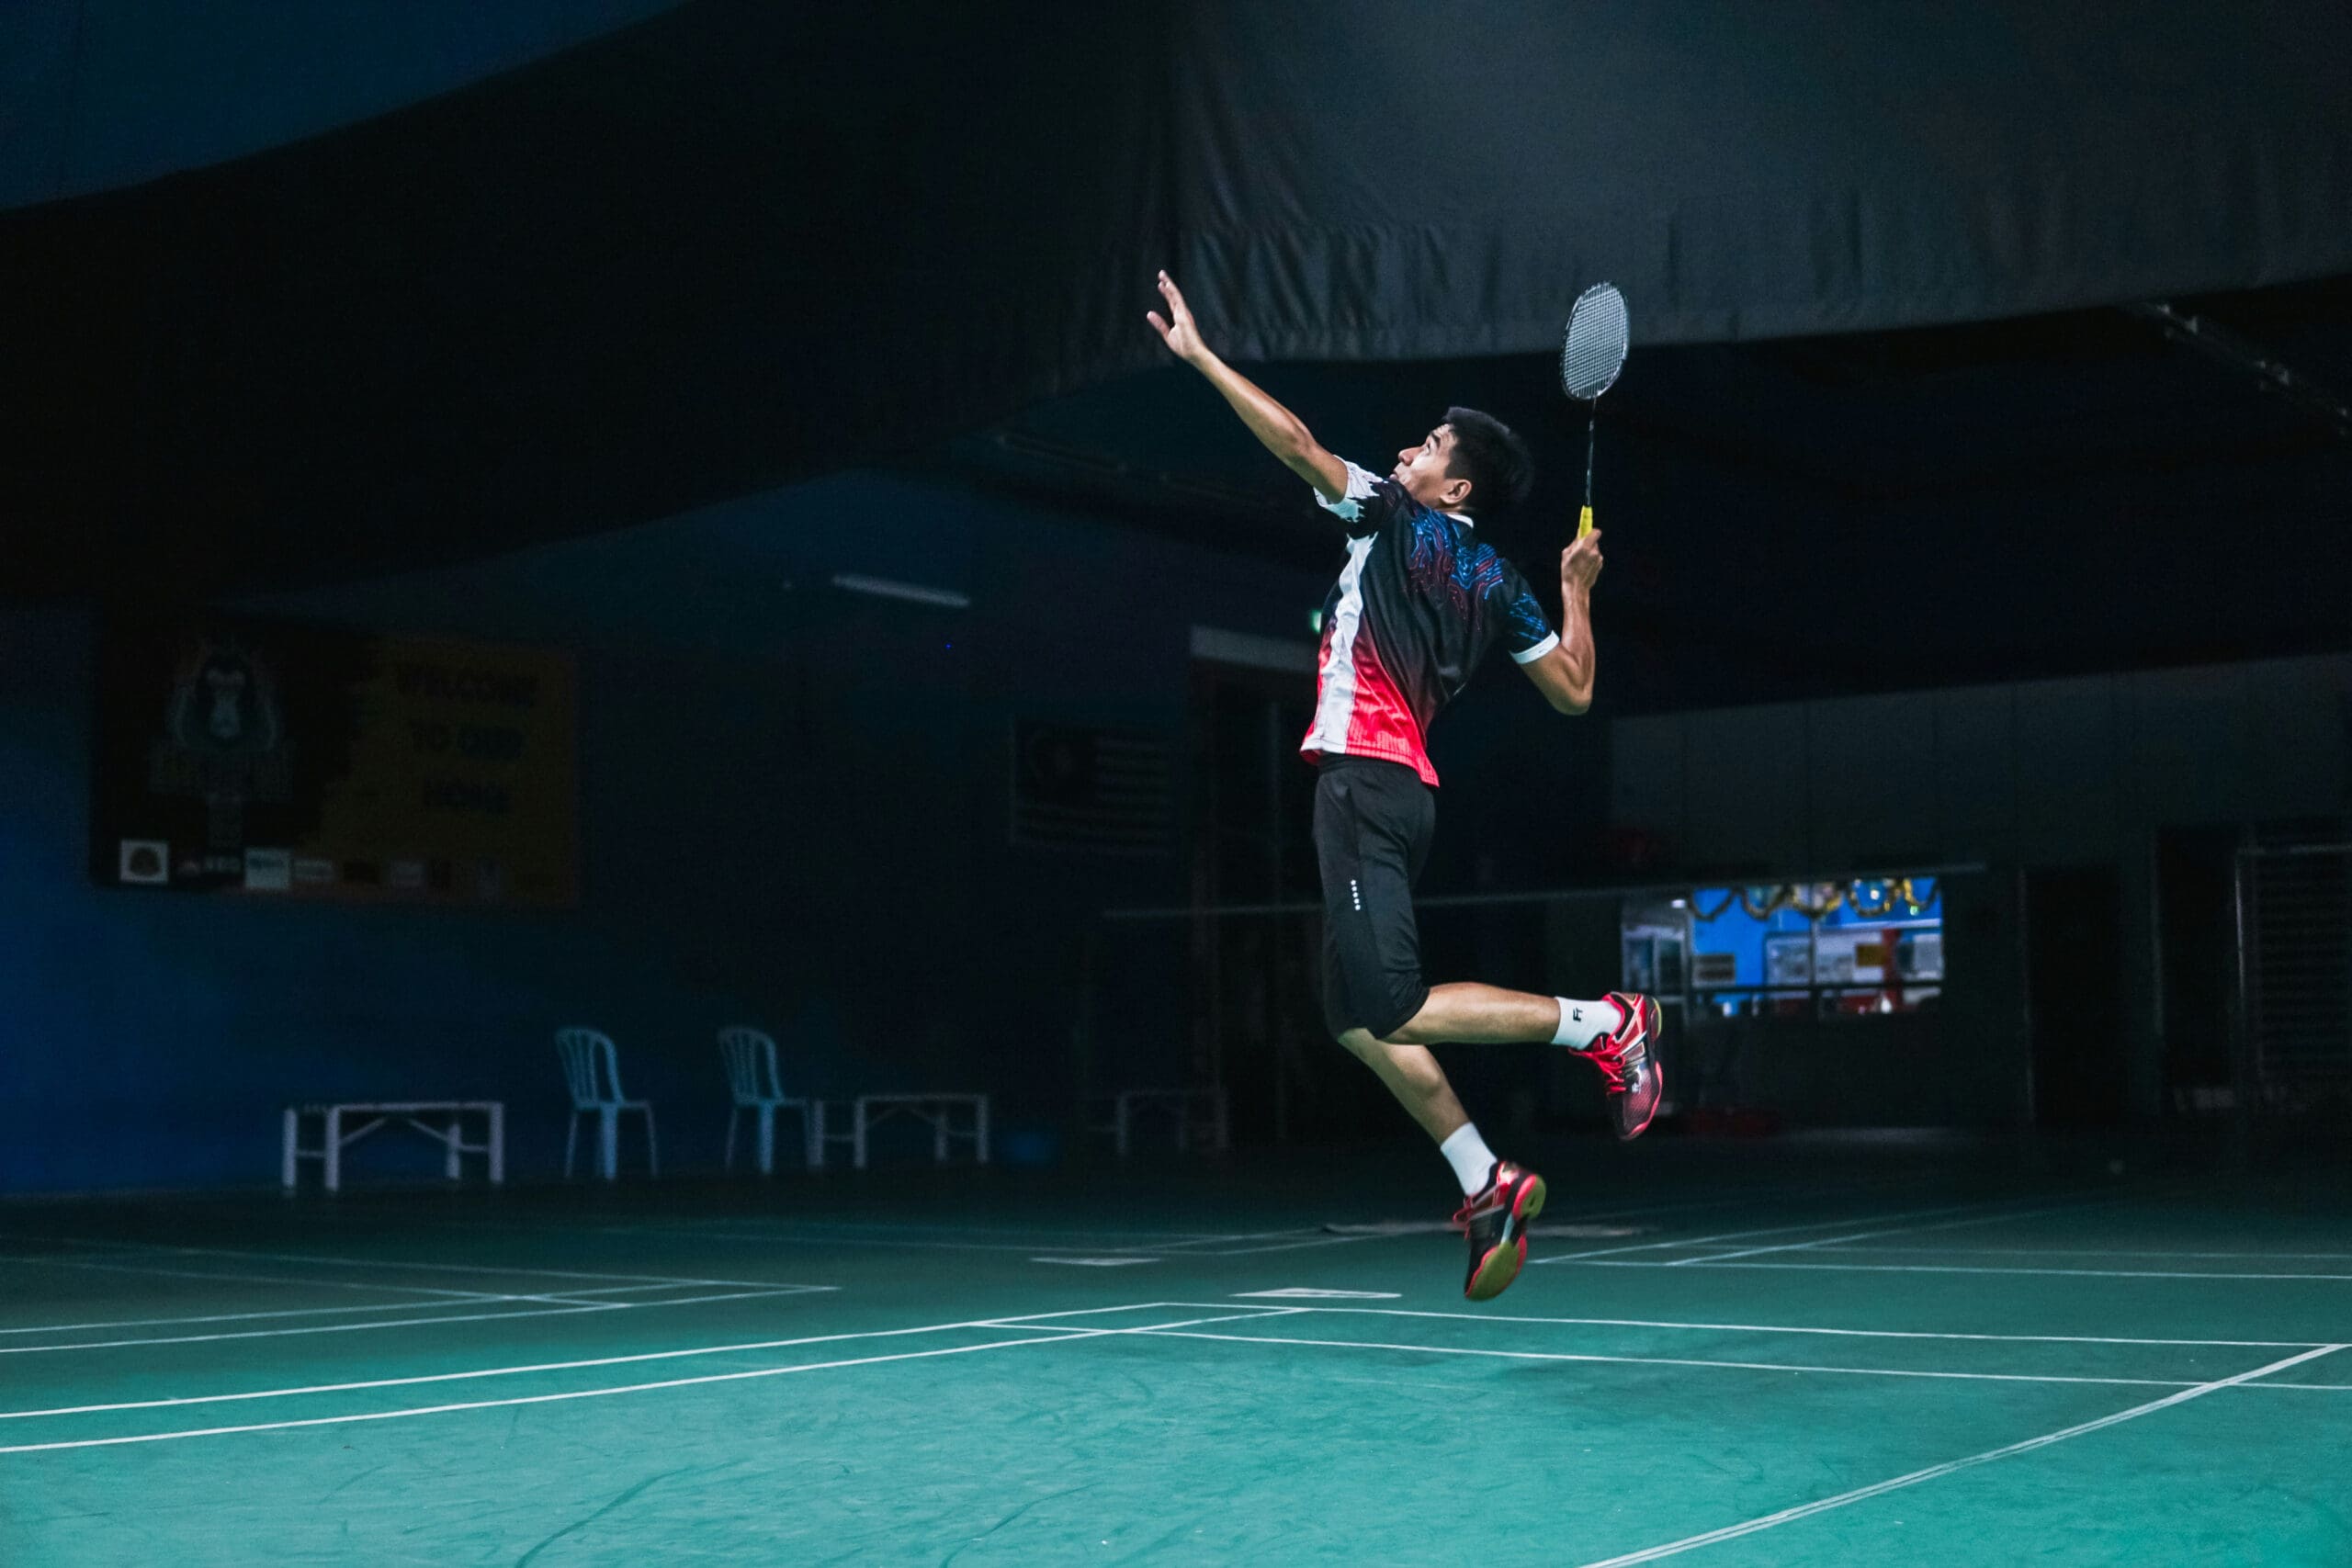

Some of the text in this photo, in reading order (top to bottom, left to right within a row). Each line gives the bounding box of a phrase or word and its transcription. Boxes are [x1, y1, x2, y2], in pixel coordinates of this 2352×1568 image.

[393, 663, 538, 707] WELCOME
[409, 721, 525, 761] TO OUR
